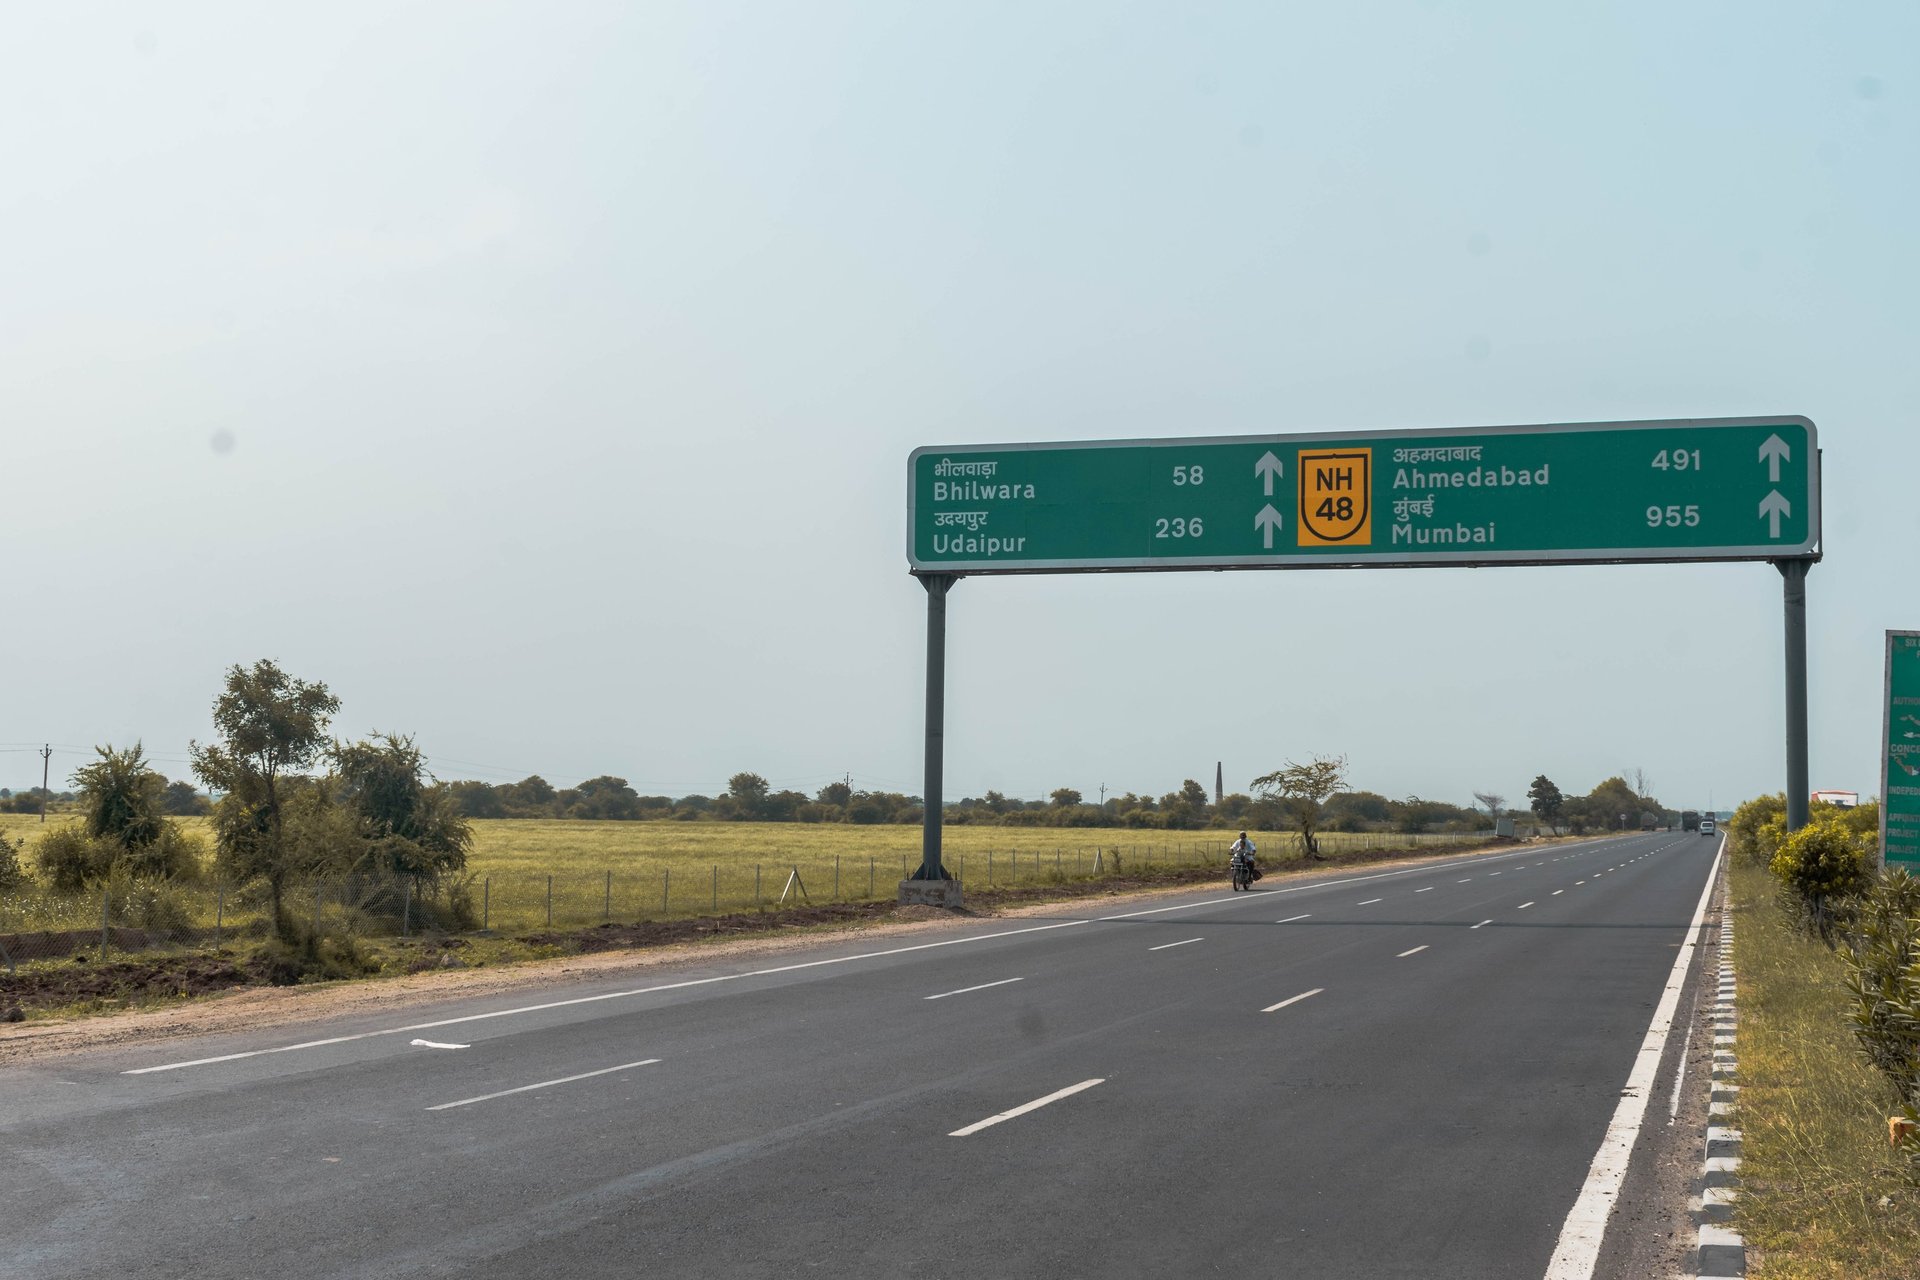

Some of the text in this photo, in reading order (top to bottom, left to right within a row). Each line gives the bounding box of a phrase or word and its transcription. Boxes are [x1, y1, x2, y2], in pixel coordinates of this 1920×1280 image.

[1392, 445, 1483, 464] अहमदाबाद
[1651, 448, 1700, 471] 491
[934, 458, 998, 480] भीलवाड़ा
[1172, 465, 1204, 486] 58
[1316, 467, 1353, 491] NH
[1392, 463, 1549, 489] Ahmedabad
[934, 481, 1036, 501] Bhilwara
[1315, 496, 1353, 521] 48
[1392, 494, 1435, 522] मुंबई
[1646, 505, 1700, 528] 955
[934, 511, 989, 531] उदयपुर
[1155, 517, 1204, 539] 236
[933, 533, 1026, 557] Udaipur
[1392, 522, 1495, 545] Mumbai
